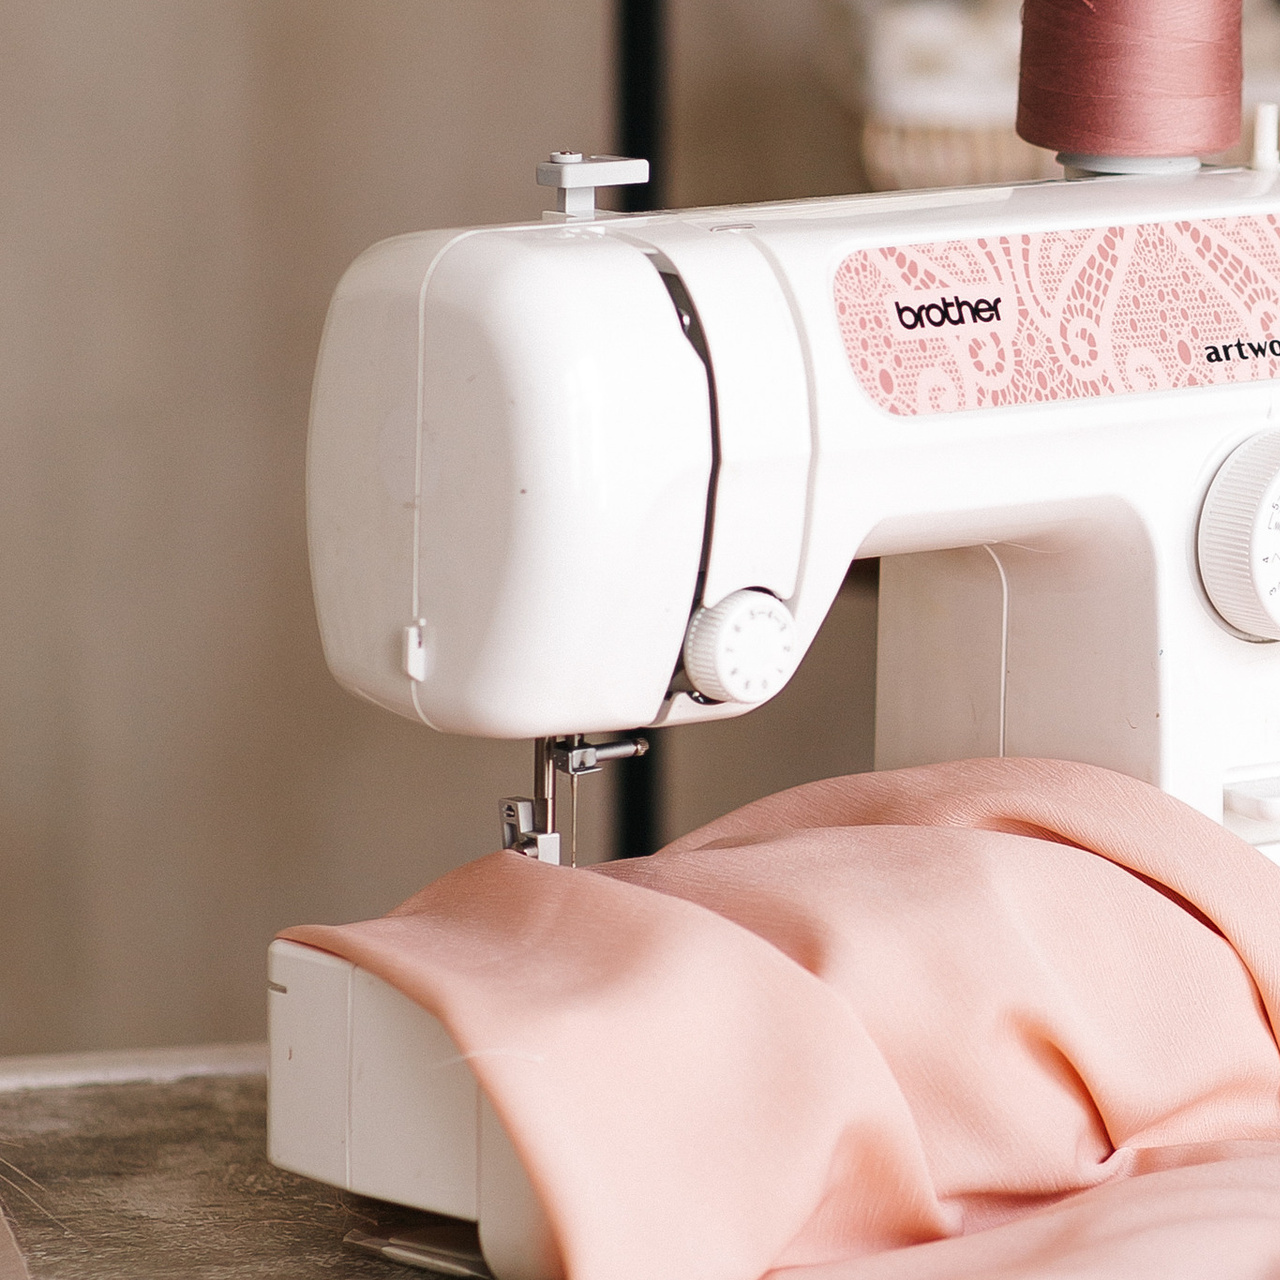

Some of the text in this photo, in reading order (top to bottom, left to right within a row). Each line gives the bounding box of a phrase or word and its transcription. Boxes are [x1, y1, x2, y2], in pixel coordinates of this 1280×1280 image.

[895, 295, 1001, 330] brother
[1271, 502, 1280, 511] 5
[1269, 586, 1277, 596] 3
